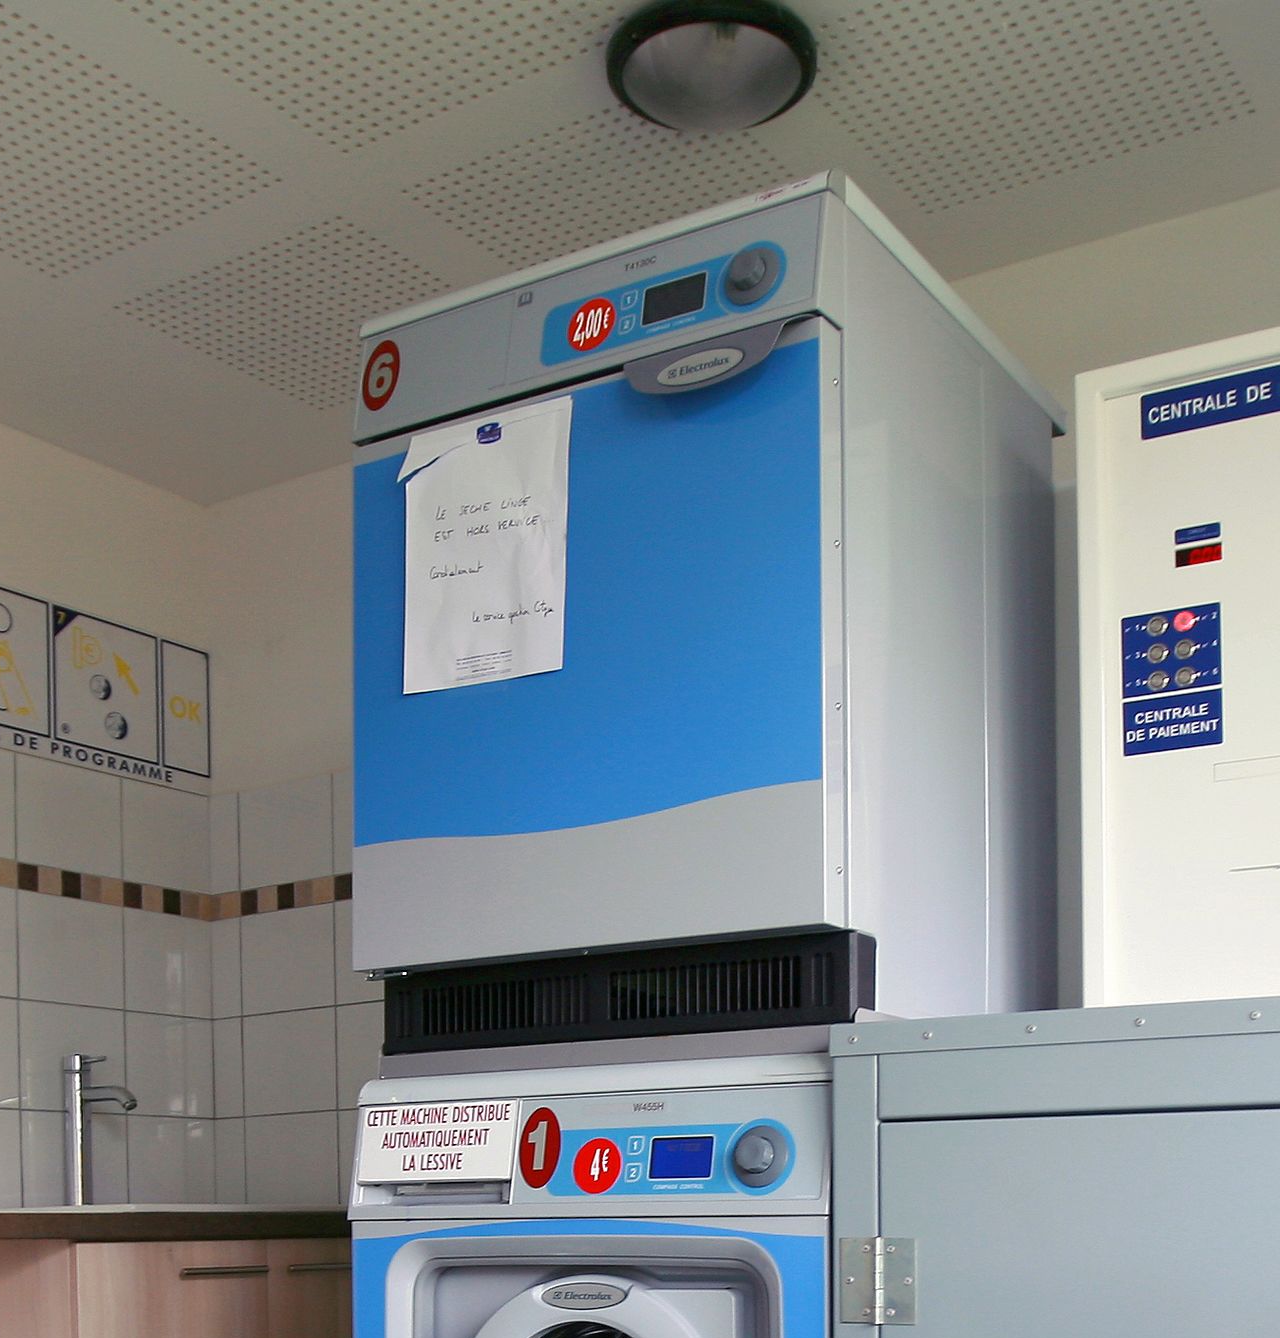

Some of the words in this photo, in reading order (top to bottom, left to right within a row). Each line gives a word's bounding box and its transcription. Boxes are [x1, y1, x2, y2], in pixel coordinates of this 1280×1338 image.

[572, 306, 612, 347] 2,00€
[367, 352, 395, 399] 6
[679, 356, 730, 377] Electrolux
[1148, 389, 1238, 424] CENTRALE
[1246, 381, 1273, 404] DE
[168, 695, 203, 725] OK
[1134, 703, 1209, 725] CENTRALE
[1126, 729, 1146, 743] DE
[1149, 718, 1220, 740] PAIEMENT
[13, 732, 39, 750] DE
[50, 741, 174, 783] PROGRAMME
[366, 1109, 398, 1127] CETTE
[399, 1106, 449, 1126] MACHINE
[452, 1103, 512, 1123] DISTRIBUE
[380, 1127, 491, 1150] AUTOMATIQUEMENT
[527, 1120, 549, 1172] 1
[632, 1140, 639, 1151] 1
[401, 1154, 416, 1172] LA
[419, 1152, 463, 1172] LESSIVE
[590, 1147, 611, 1183] 4€
[628, 1167, 638, 1178] 2
[563, 1291, 613, 1301] Electrolux
